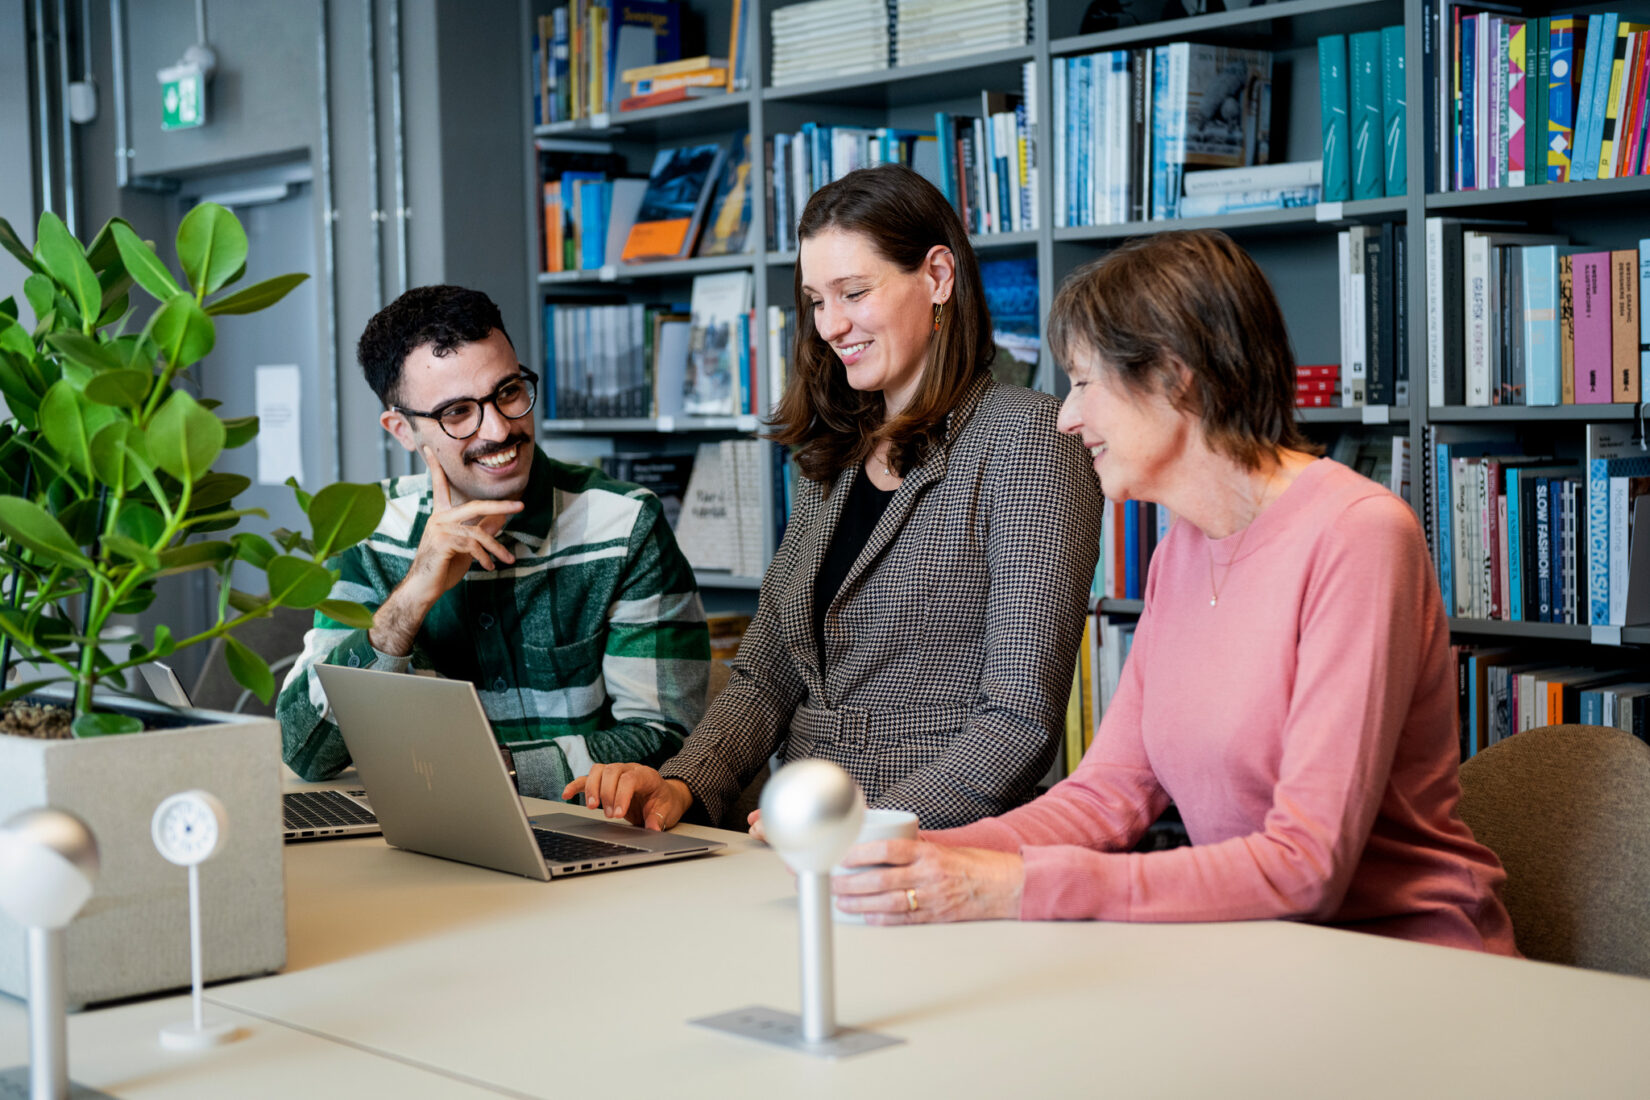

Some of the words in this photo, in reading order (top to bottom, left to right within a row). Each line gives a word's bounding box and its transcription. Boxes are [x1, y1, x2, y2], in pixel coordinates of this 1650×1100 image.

[1499, 33, 1509, 61] The
[1499, 63, 1509, 110] Forests
[1499, 112, 1509, 127] of
[1499, 131, 1509, 176] Venice
[1472, 277, 1484, 321] GRAFISK
[1536, 485, 1548, 522] SLOW
[1509, 510, 1518, 580] FASHIONISTA
[1537, 523, 1550, 579] FASHION
[1591, 479, 1608, 603] SNOWCRASH
